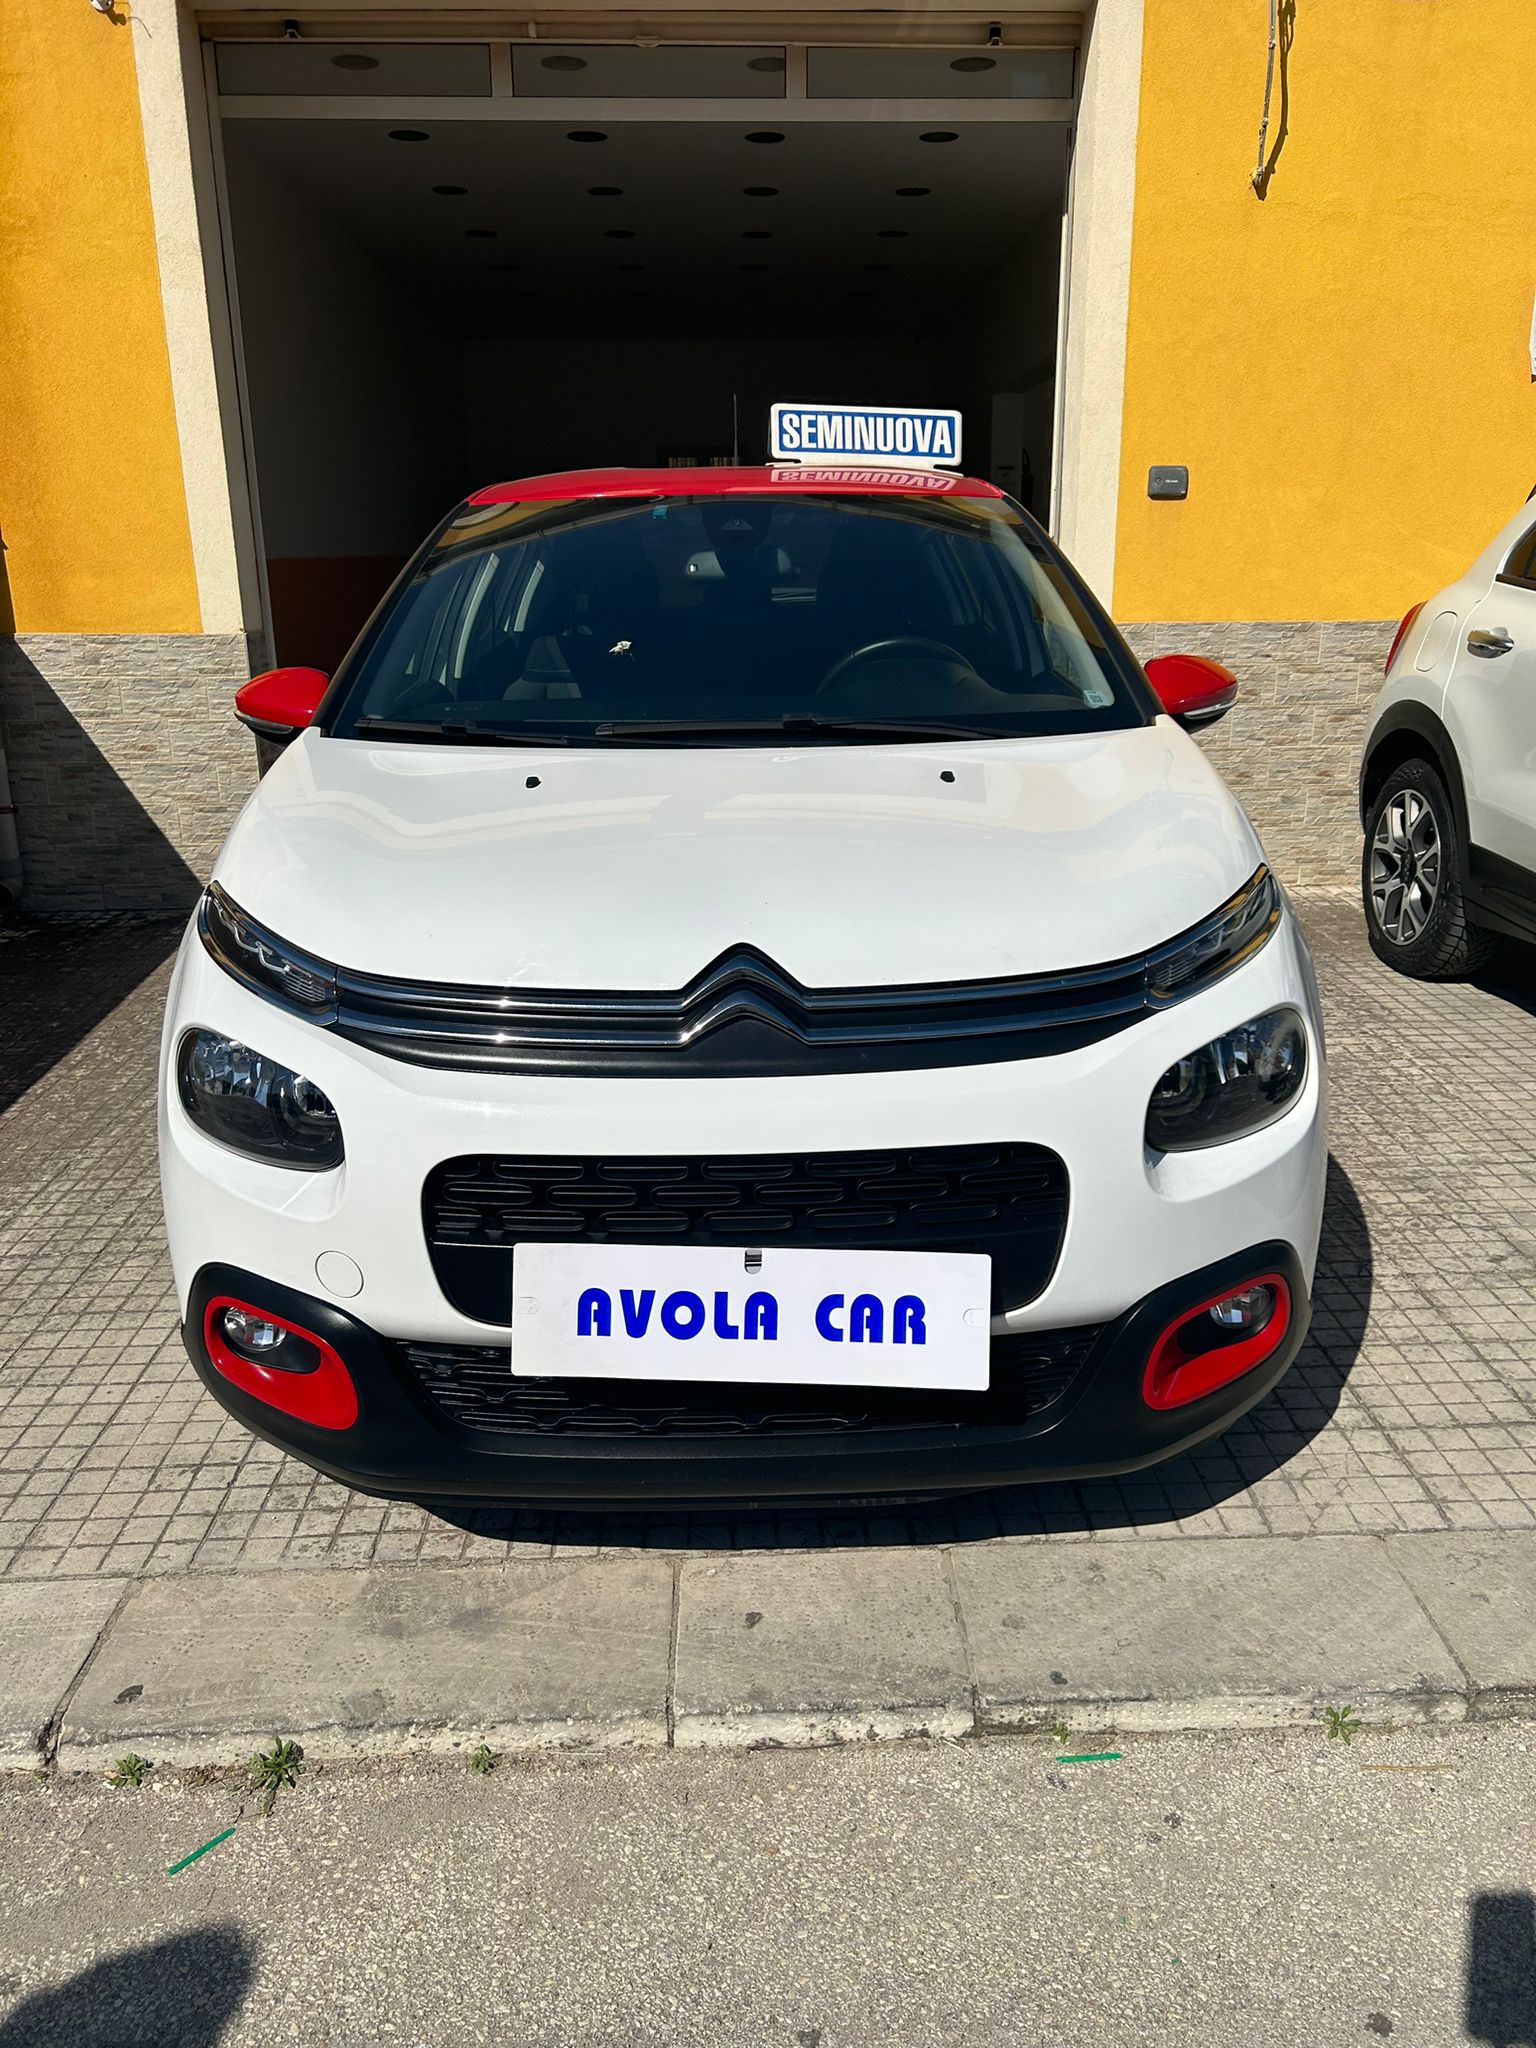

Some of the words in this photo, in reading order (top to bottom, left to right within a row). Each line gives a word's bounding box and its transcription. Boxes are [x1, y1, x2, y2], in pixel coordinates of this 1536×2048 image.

[782, 413, 953, 454] SEMINUOVA
[577, 1287, 779, 1341] AVOLA
[815, 1293, 927, 1345] CAR
